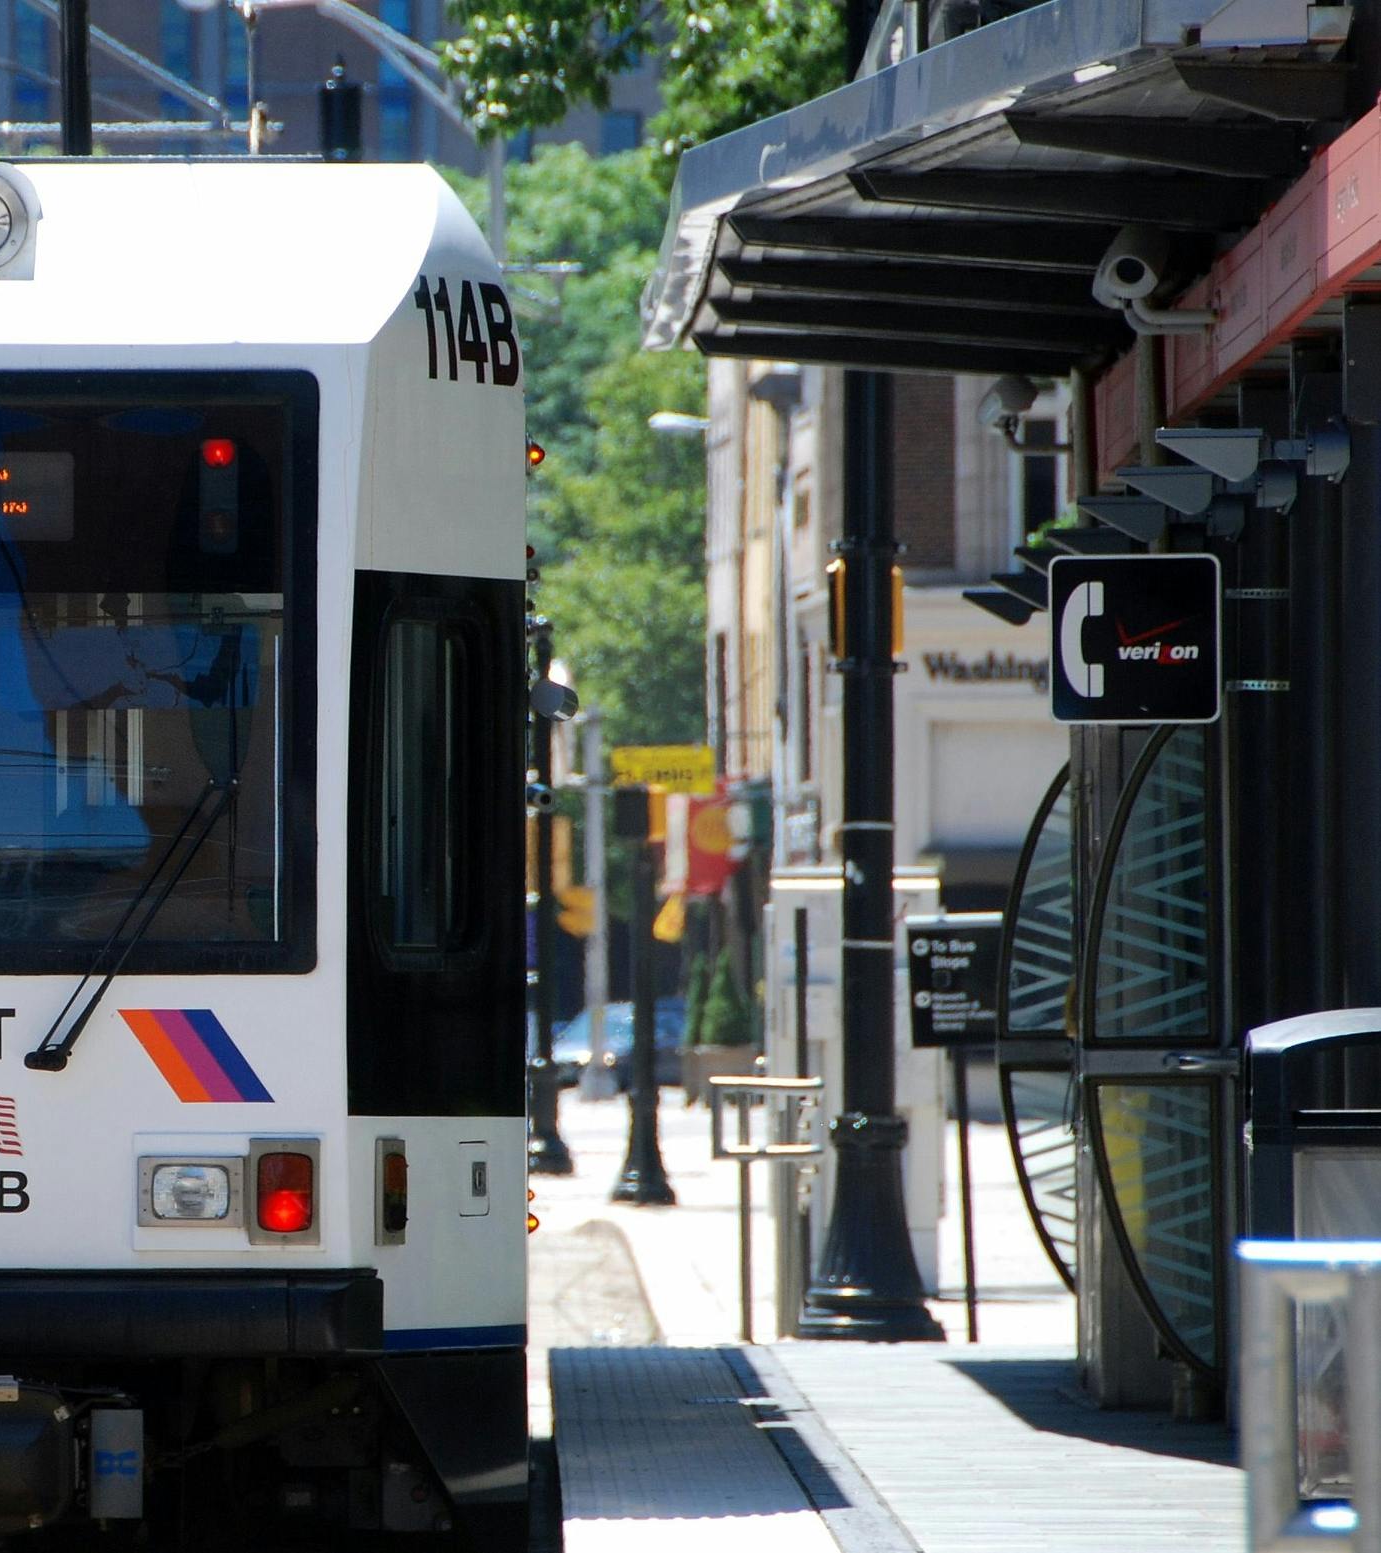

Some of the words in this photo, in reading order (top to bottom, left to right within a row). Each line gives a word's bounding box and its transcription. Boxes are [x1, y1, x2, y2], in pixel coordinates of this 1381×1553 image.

[414, 274, 519, 387] 114B
[1117, 641, 1200, 666] verizon
[931, 940, 948, 953] To
[949, 939, 977, 953] Bus
